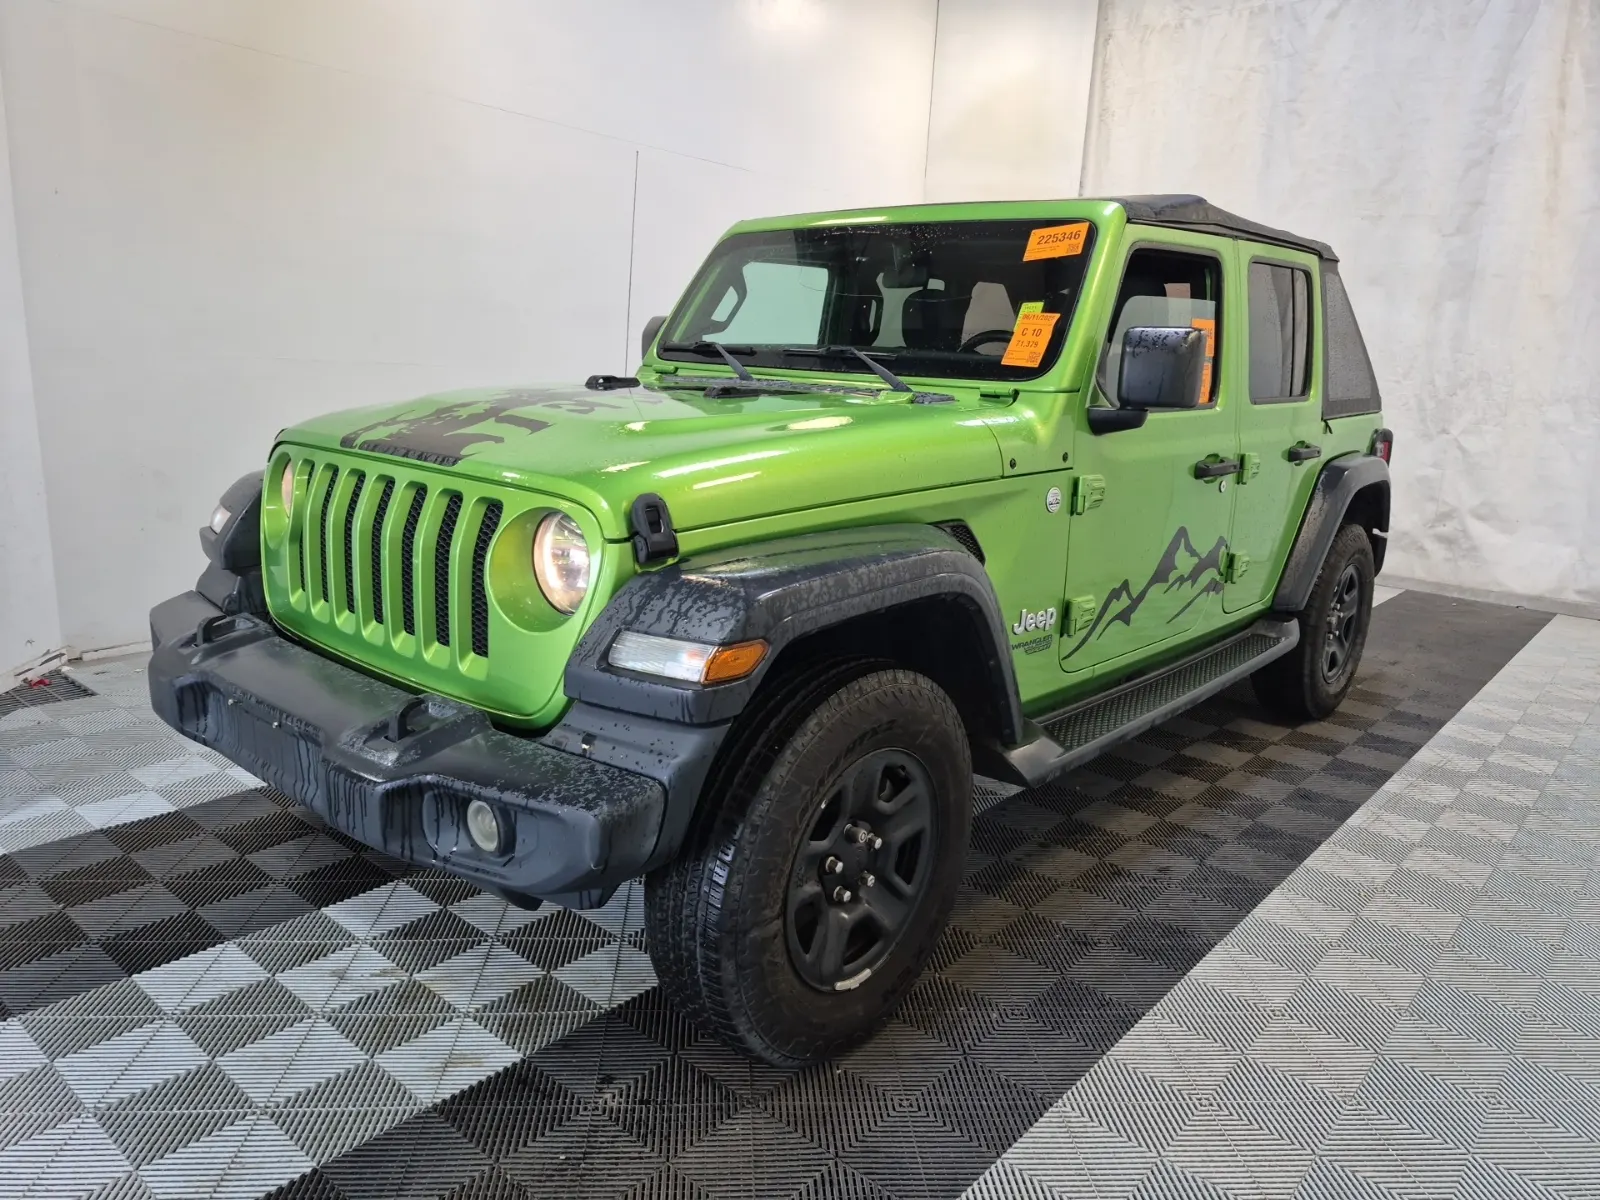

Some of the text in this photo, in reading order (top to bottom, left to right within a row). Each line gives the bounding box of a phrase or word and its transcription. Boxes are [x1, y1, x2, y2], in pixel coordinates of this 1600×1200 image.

[1037, 230, 1081, 245] 225346
[1021, 327, 1043, 337] C 10
[1015, 340, 1039, 348] 71,379
[1012, 607, 1057, 635] Jeep
[1012, 634, 1053, 650] WRANGLER
